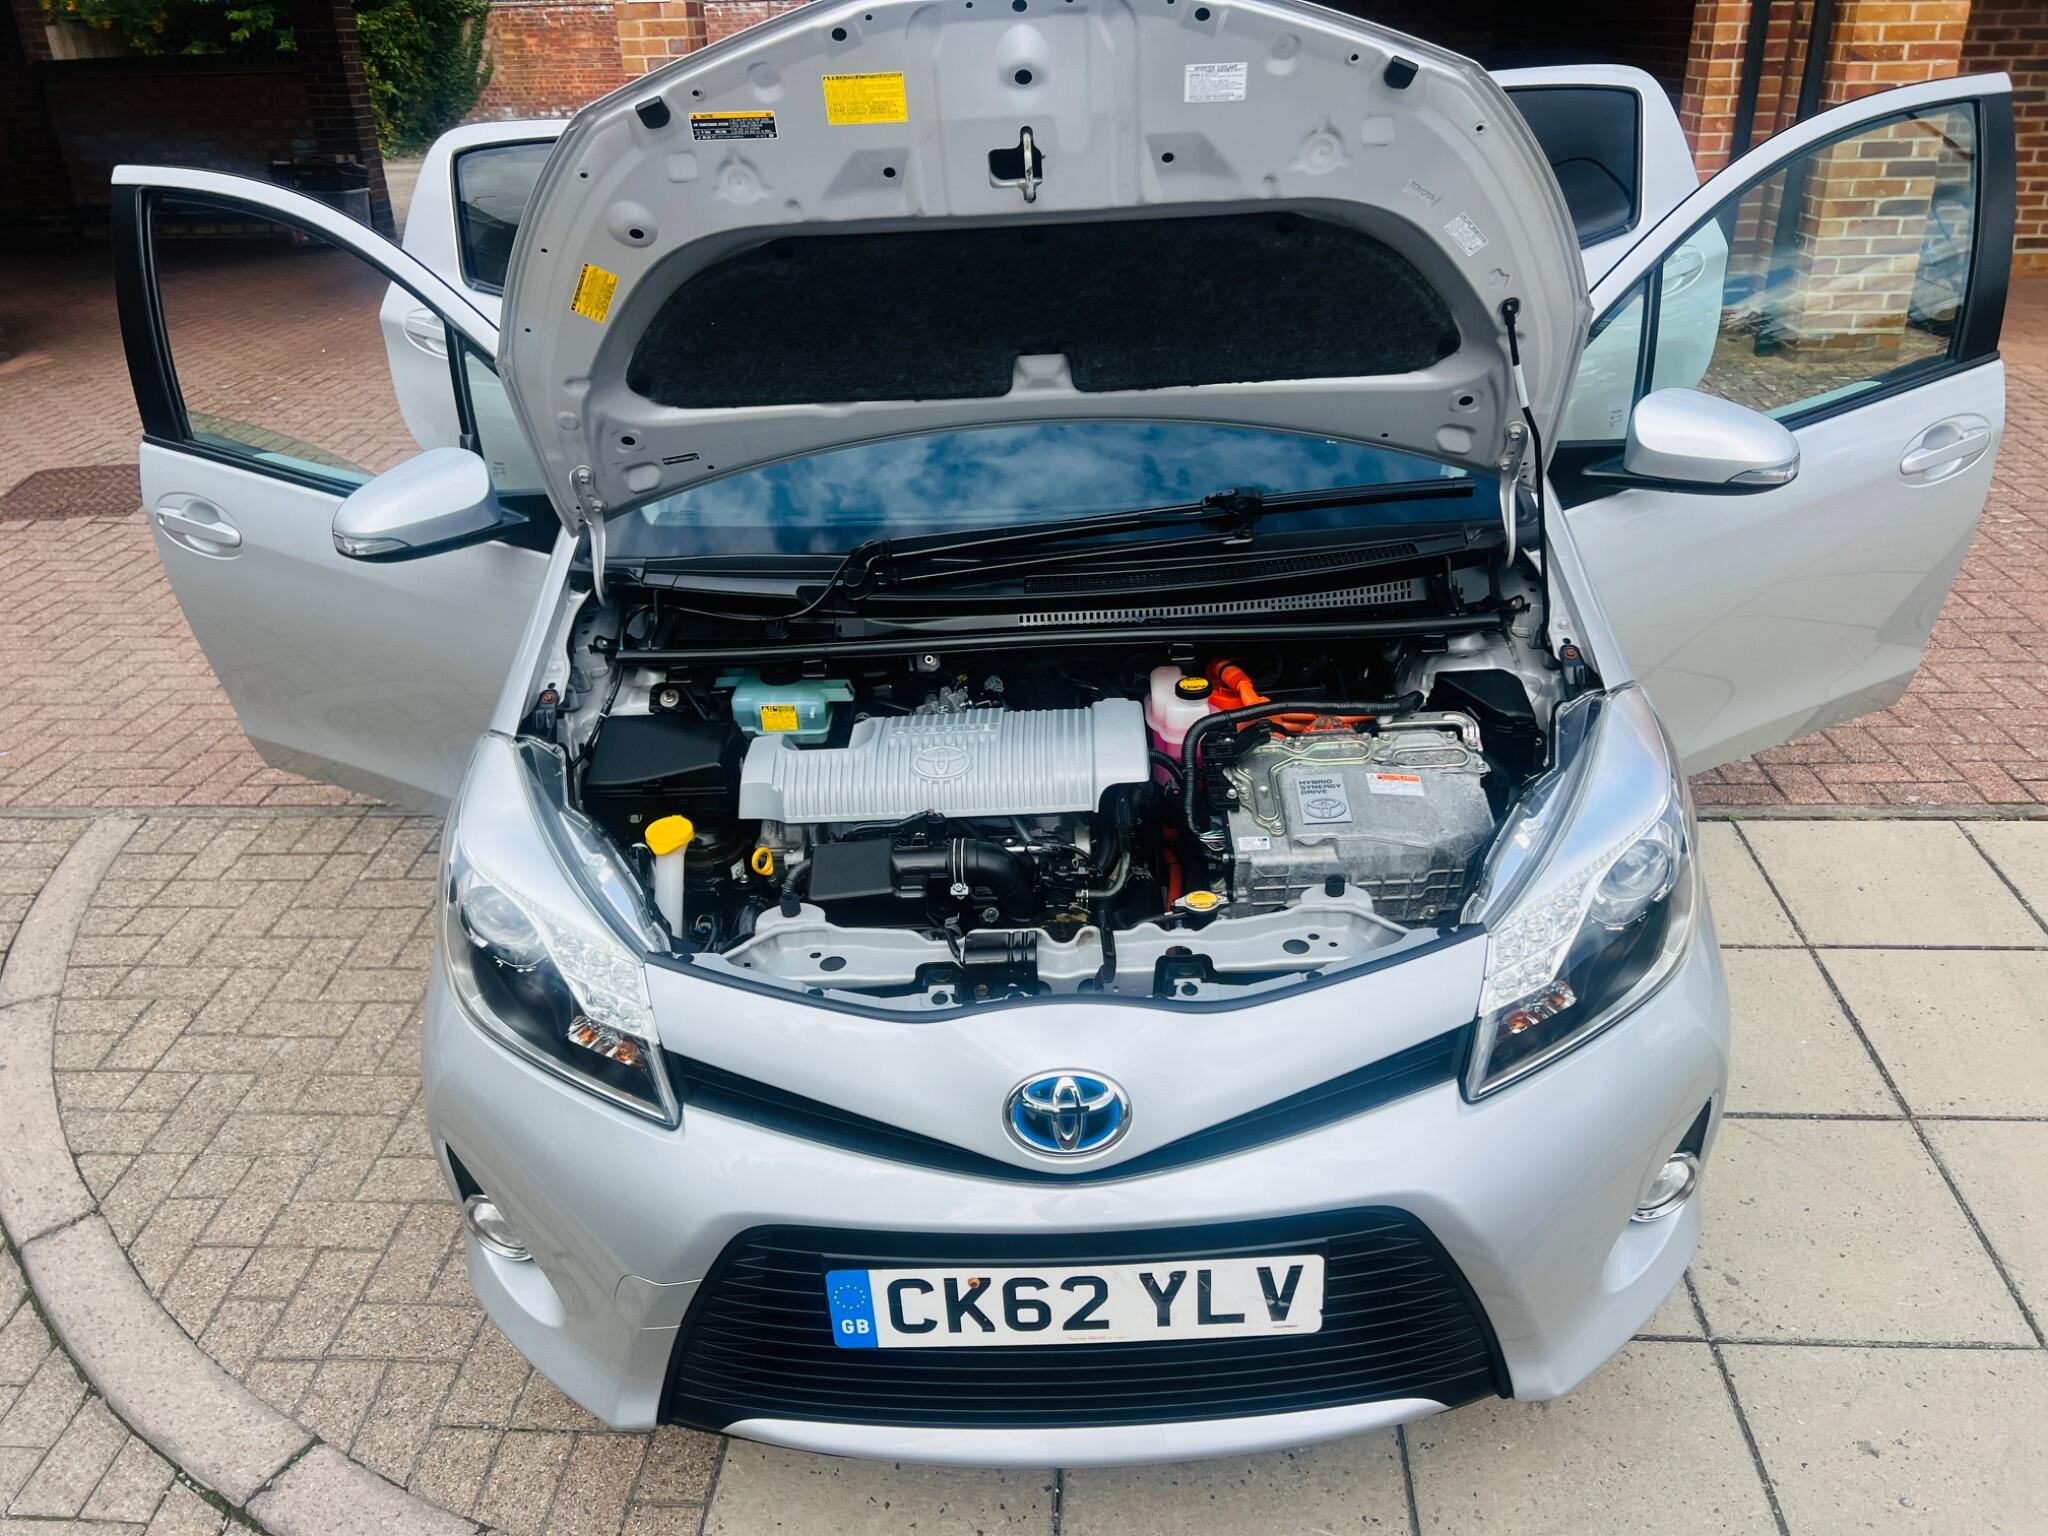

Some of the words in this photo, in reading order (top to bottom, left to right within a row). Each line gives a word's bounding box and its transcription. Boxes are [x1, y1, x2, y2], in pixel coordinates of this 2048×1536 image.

[1408, 180, 1436, 201] TOYOTA
[887, 1275, 1110, 1334] CK62
[1138, 1264, 1304, 1328] YLV
[841, 1318, 870, 1335] GB
